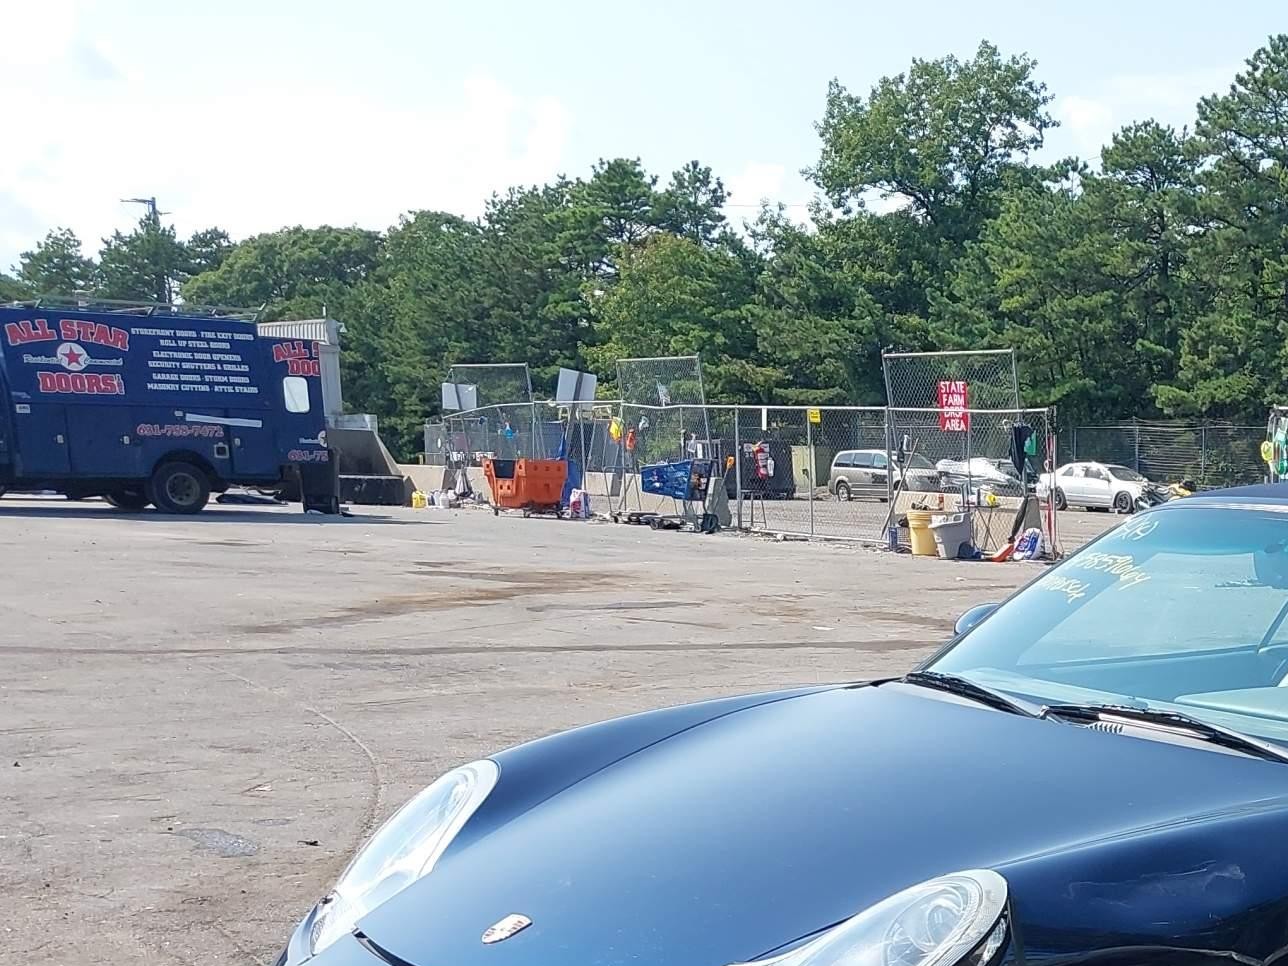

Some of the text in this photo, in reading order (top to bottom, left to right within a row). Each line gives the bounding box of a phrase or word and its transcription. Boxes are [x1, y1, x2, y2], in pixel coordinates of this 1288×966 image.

[5, 319, 129, 351] ALL STAR
[188, 340, 209, 348] STEEL
[273, 341, 309, 362] ALL
[37, 371, 117, 394] DOORS
[940, 381, 965, 393] STATE
[942, 394, 965, 406] FARM
[945, 419, 966, 431] AREA
